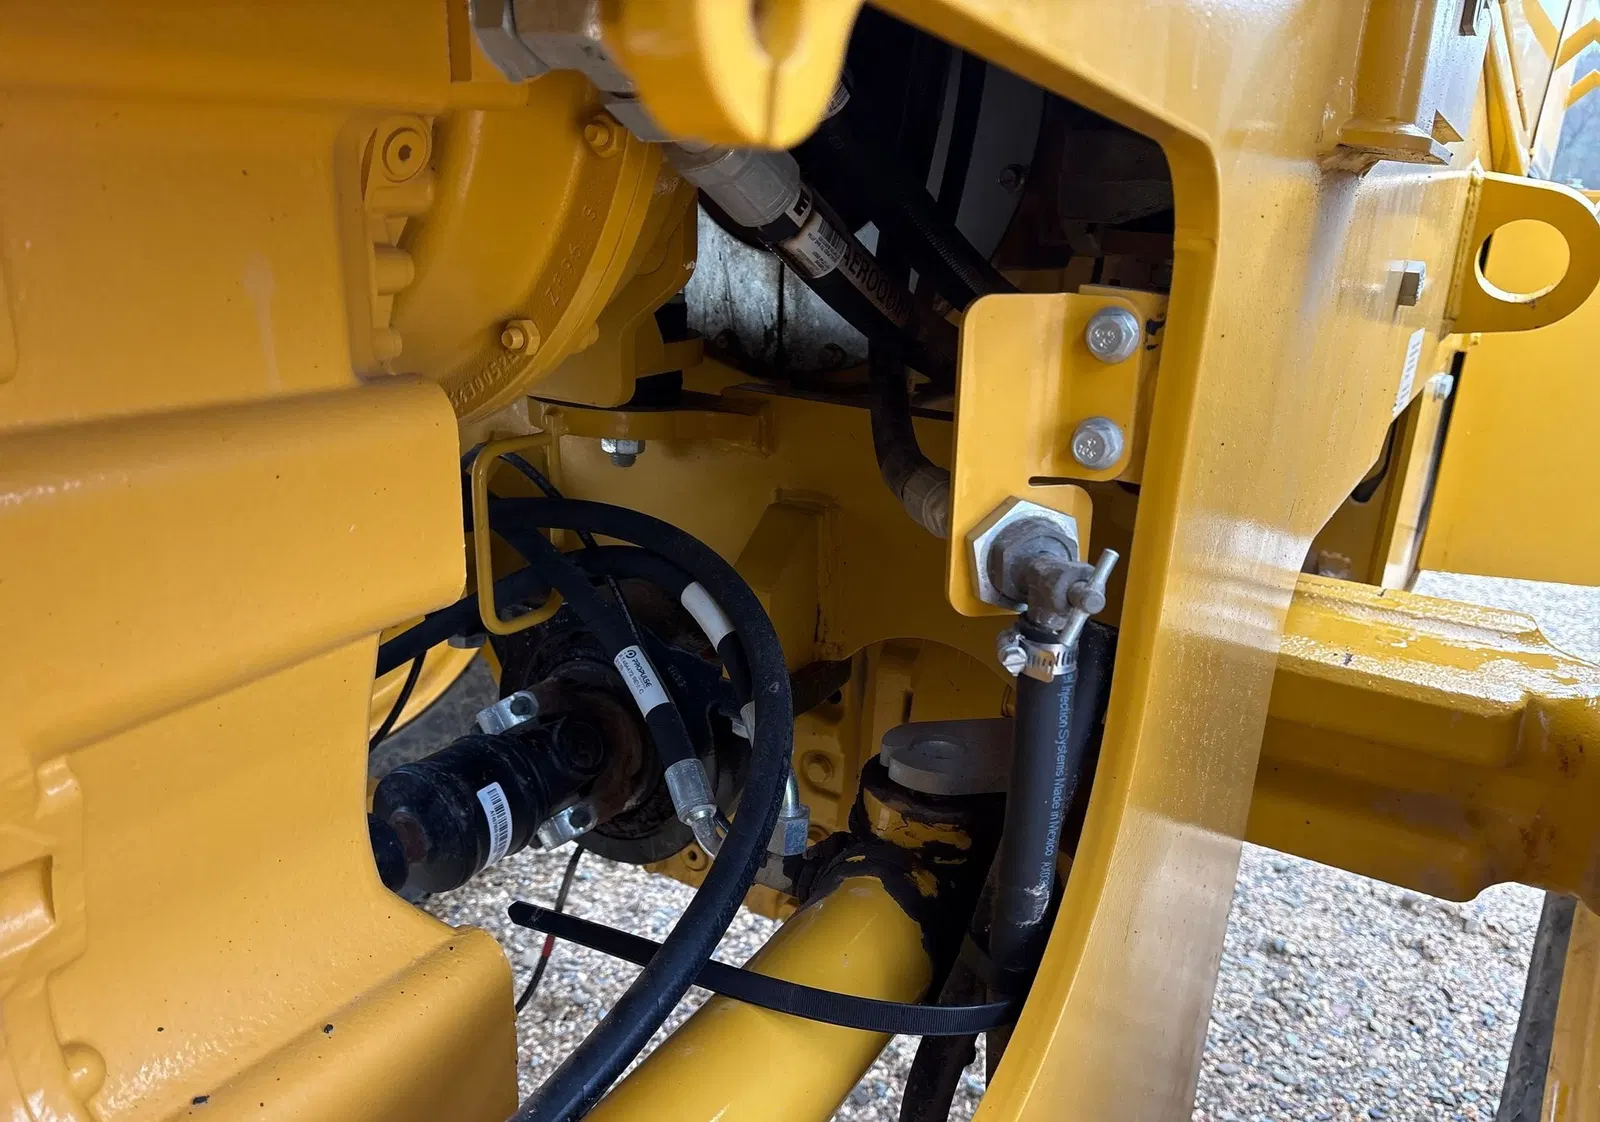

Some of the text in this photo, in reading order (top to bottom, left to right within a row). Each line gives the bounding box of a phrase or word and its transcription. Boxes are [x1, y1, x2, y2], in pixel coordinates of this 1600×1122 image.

[632, 658, 652, 688] PROPULSE
[1057, 685, 1073, 728] Injection
[1054, 728, 1069, 777] Systems
[1051, 778, 1066, 810] Made
[1049, 811, 1059, 820] in
[1044, 820, 1059, 856] Mexico
